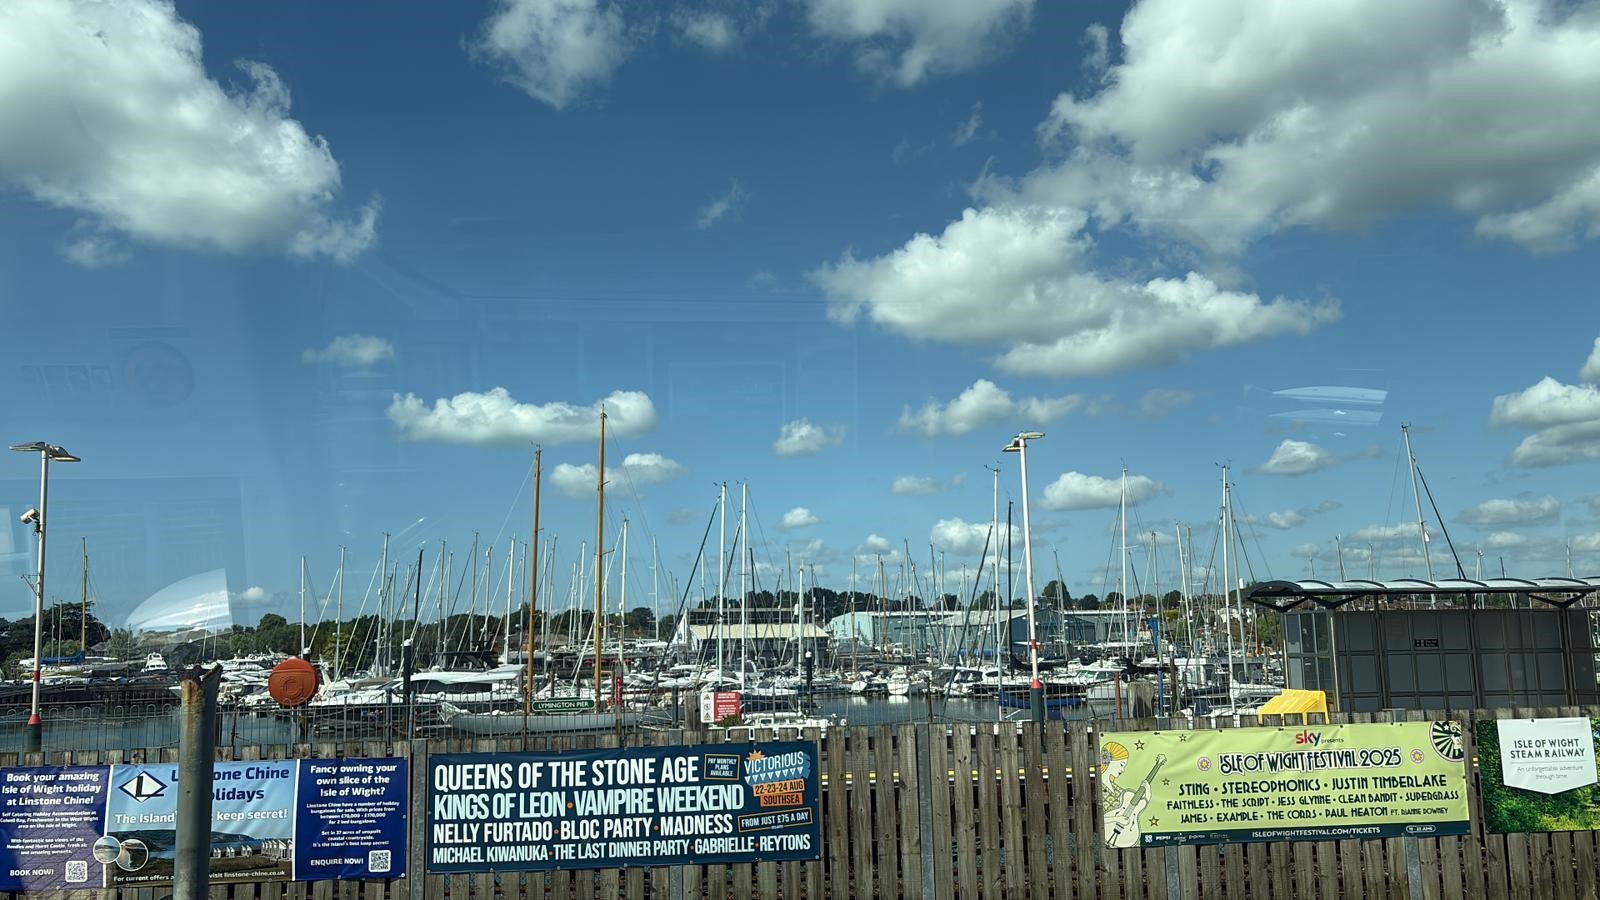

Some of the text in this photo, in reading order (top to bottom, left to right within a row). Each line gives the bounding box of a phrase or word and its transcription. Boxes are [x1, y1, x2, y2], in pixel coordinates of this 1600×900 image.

[1296, 730, 1322, 746] sky
[1548, 739, 1579, 747] WIGHT
[1510, 749, 1584, 758] STEAM RAILWAY
[744, 751, 804, 774] VICTORIOUS
[1220, 749, 1401, 774] ISLE OF WIGHT FESTIVAL 2025
[245, 767, 290, 780] Chine
[310, 764, 397, 774] Fancy owning your
[434, 756, 699, 792] QUEENS OF THE STONE AGE
[7, 772, 100, 782] Book your amazing
[339, 776, 359, 784] slice
[20, 785, 31, 794] of
[34, 784, 64, 794] Wight
[66, 784, 101, 794] holiday
[755, 780, 803, 795] 22-23-24 AUG
[1179, 774, 1447, 795] STING STEREOPHONICS JUSTIN TIMBERLAKE
[352, 787, 386, 797] Wight?
[19, 798, 61, 806] Linstone
[64, 796, 94, 804] Chine!
[434, 784, 744, 820] KINGS OF LEON VAMPIRE WEEKEND
[764, 794, 800, 804] SOUTHSEA
[1167, 791, 1459, 810] FAITHLESS THE SCRIPT JESS GLYNNE CLEAN BANDIT SUPERGRASS
[115, 814, 136, 824] The
[217, 809, 288, 821] keep secret!
[741, 819, 760, 827] FROM
[761, 816, 775, 825] JUST
[778, 814, 789, 823] £75
[796, 812, 809, 820] DAY
[1181, 814, 1207, 823] JAMES
[1217, 812, 1258, 821] EXAMPLE
[1267, 810, 1284, 820] THE
[1287, 810, 1316, 819] CORRS
[1326, 808, 1348, 818] PAUL
[1351, 806, 1387, 816] HEATON
[434, 814, 733, 843] NELLY FURTADO BLOC PARTY MADNESS
[1252, 827, 1380, 838] ISLEOFWIGHTFESTIVAL.COM/TICKETS
[433, 834, 811, 863] MICHAEL KIWANUKA THE LAST DINNER PARTY GABRIELLE REYTONS
